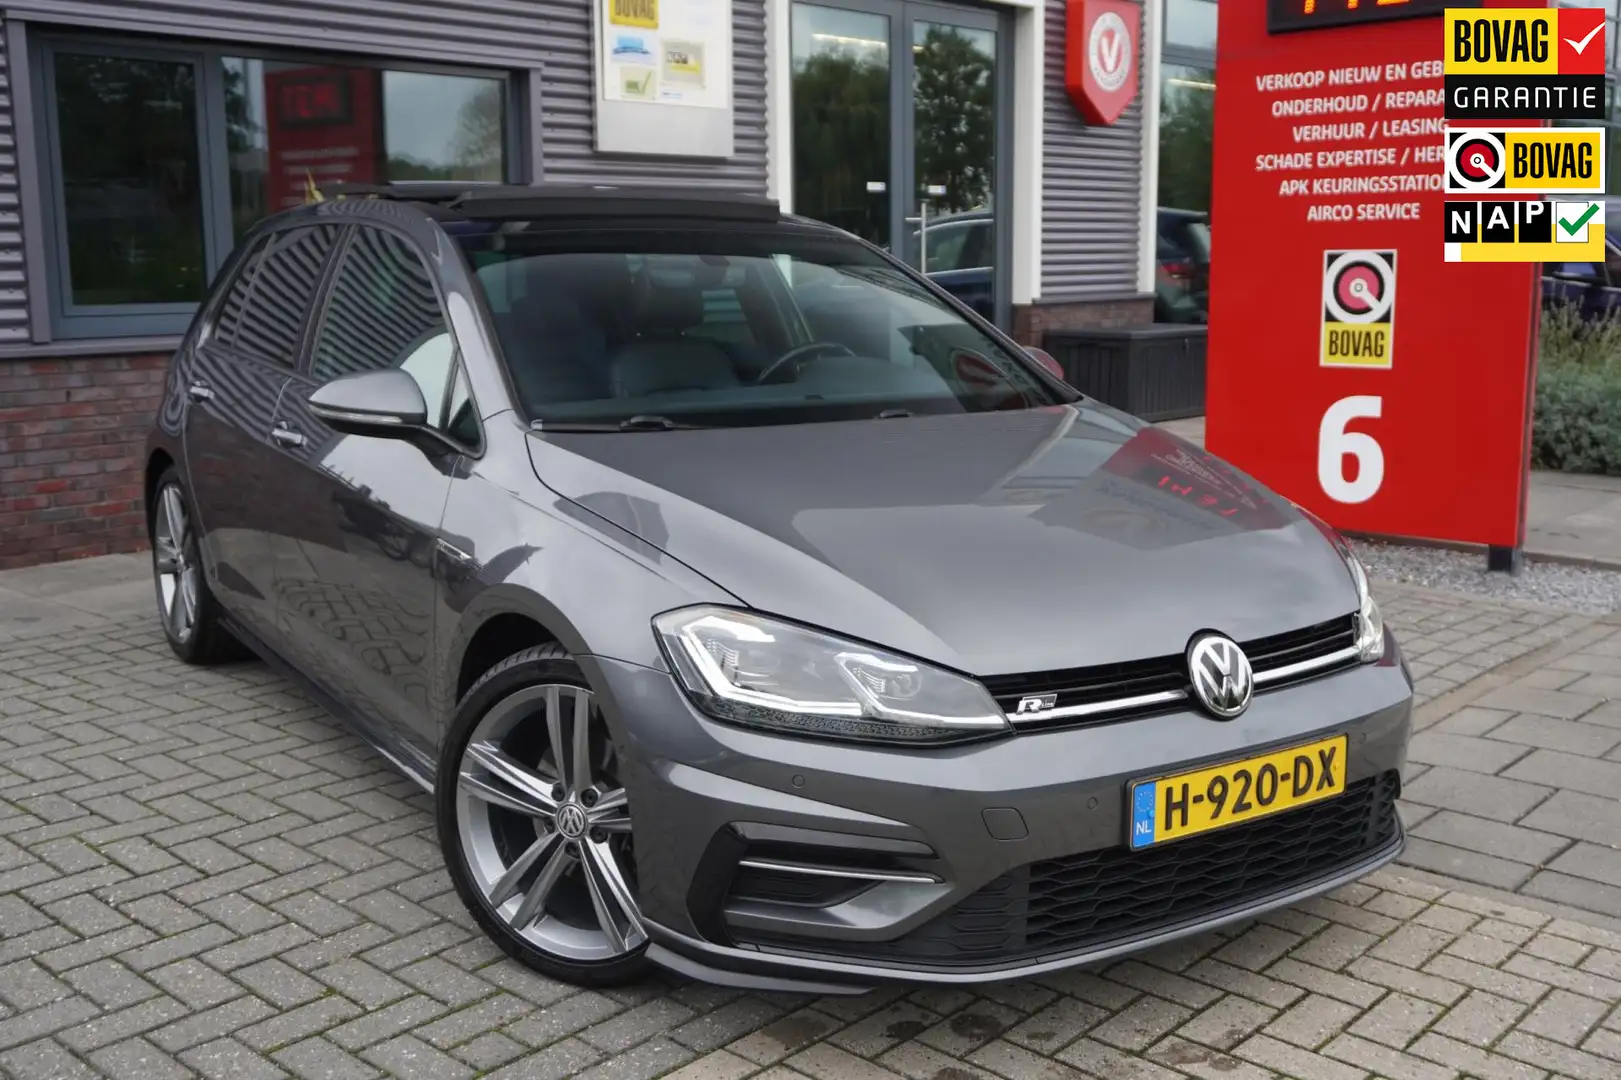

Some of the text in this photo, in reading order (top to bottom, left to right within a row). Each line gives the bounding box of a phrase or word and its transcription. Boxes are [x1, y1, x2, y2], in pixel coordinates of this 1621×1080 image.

[1256, 60, 1444, 92] VERKOOP NIEUW EN GEB
[1271, 94, 1368, 117] ONDERHOUD
[1371, 93, 1382, 113] /
[1292, 116, 1450, 142] VERHUUR / LEASING
[1255, 153, 1313, 172] SCHADE
[1316, 147, 1397, 168] EXPERTISE
[1400, 147, 1410, 167] /
[1279, 173, 1444, 196] APK KEURINGSSTATIO
[1306, 202, 1421, 222] AIRCO SERVICE
[1328, 330, 1385, 358] BOVAG
[1317, 395, 1385, 504] 6
[1164, 746, 1337, 831] H-920-DX
[1136, 821, 1152, 836] NL
